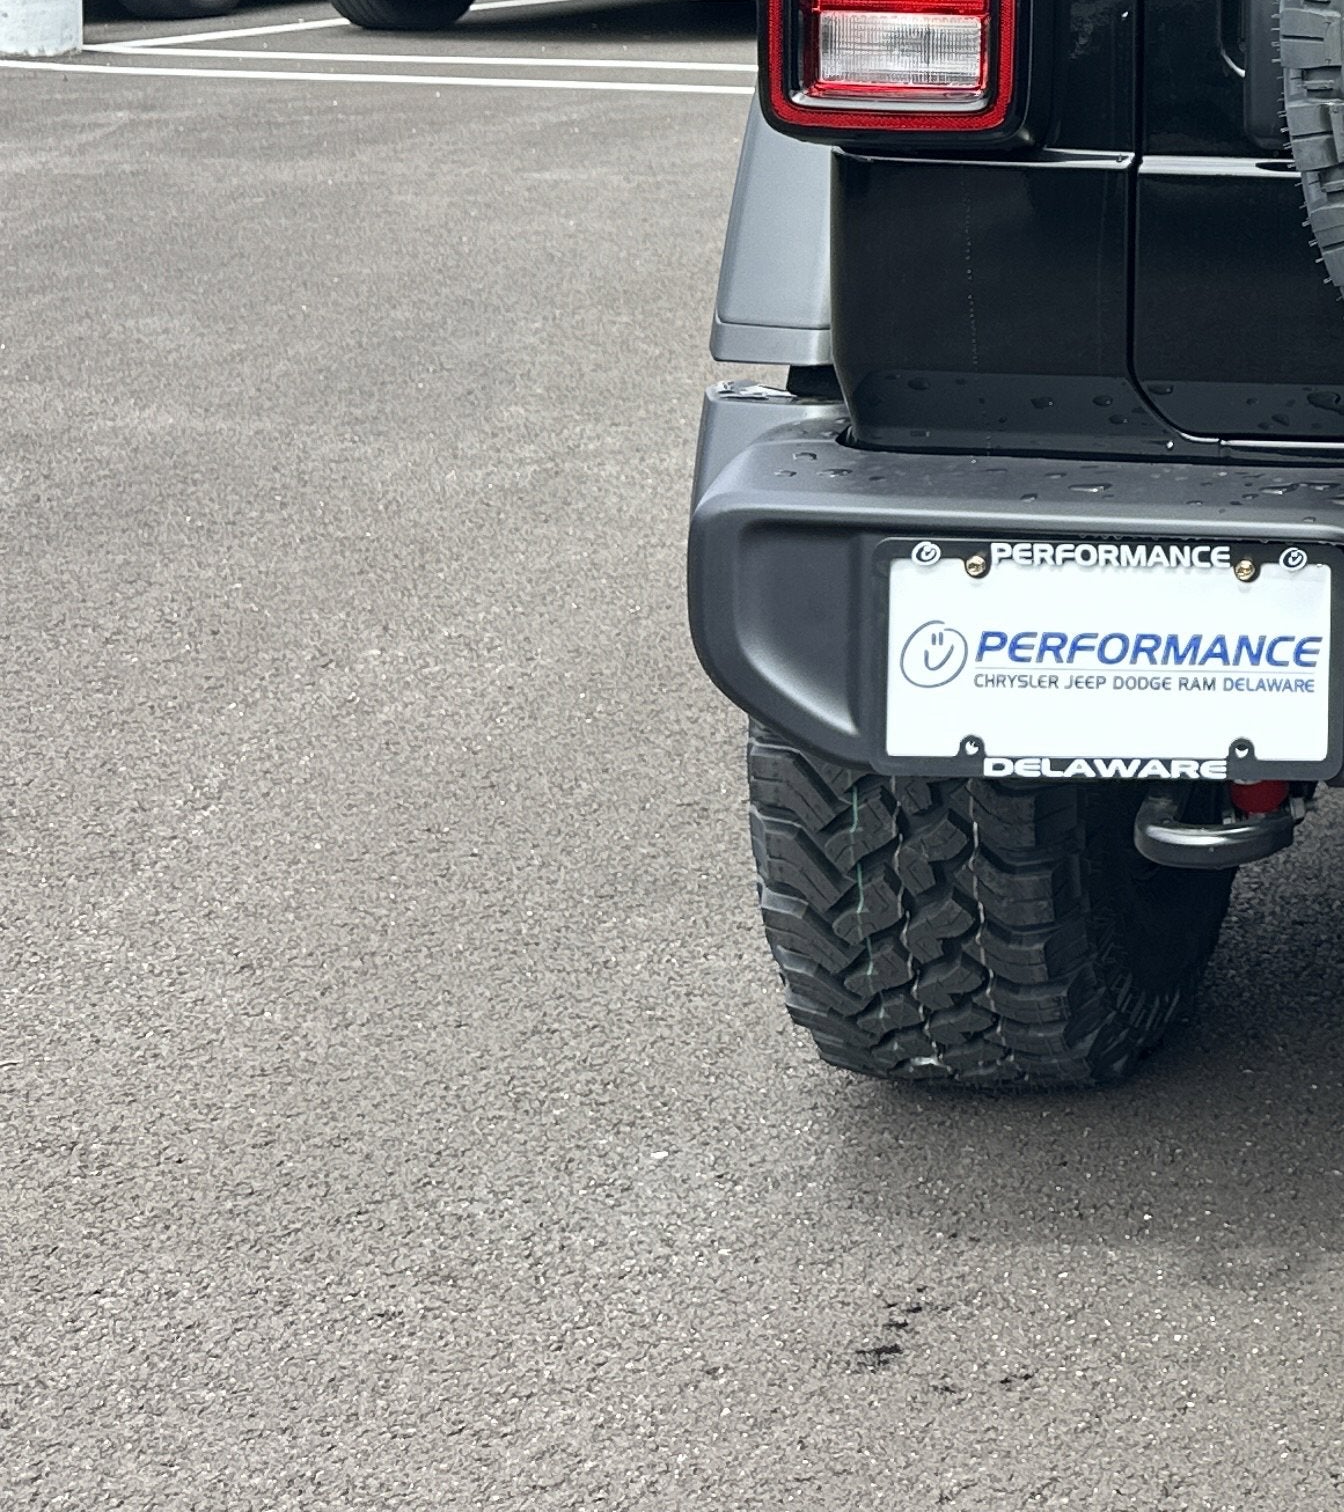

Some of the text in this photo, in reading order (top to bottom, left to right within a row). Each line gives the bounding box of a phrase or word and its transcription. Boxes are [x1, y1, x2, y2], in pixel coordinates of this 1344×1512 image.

[989, 541, 1231, 569] PERFORMANCE
[974, 630, 1324, 668] PERFORMANCE
[973, 673, 1316, 693] CHRYSLER JEEP DODGE RAM DELAWARE
[982, 756, 1229, 780] DELAWARE
